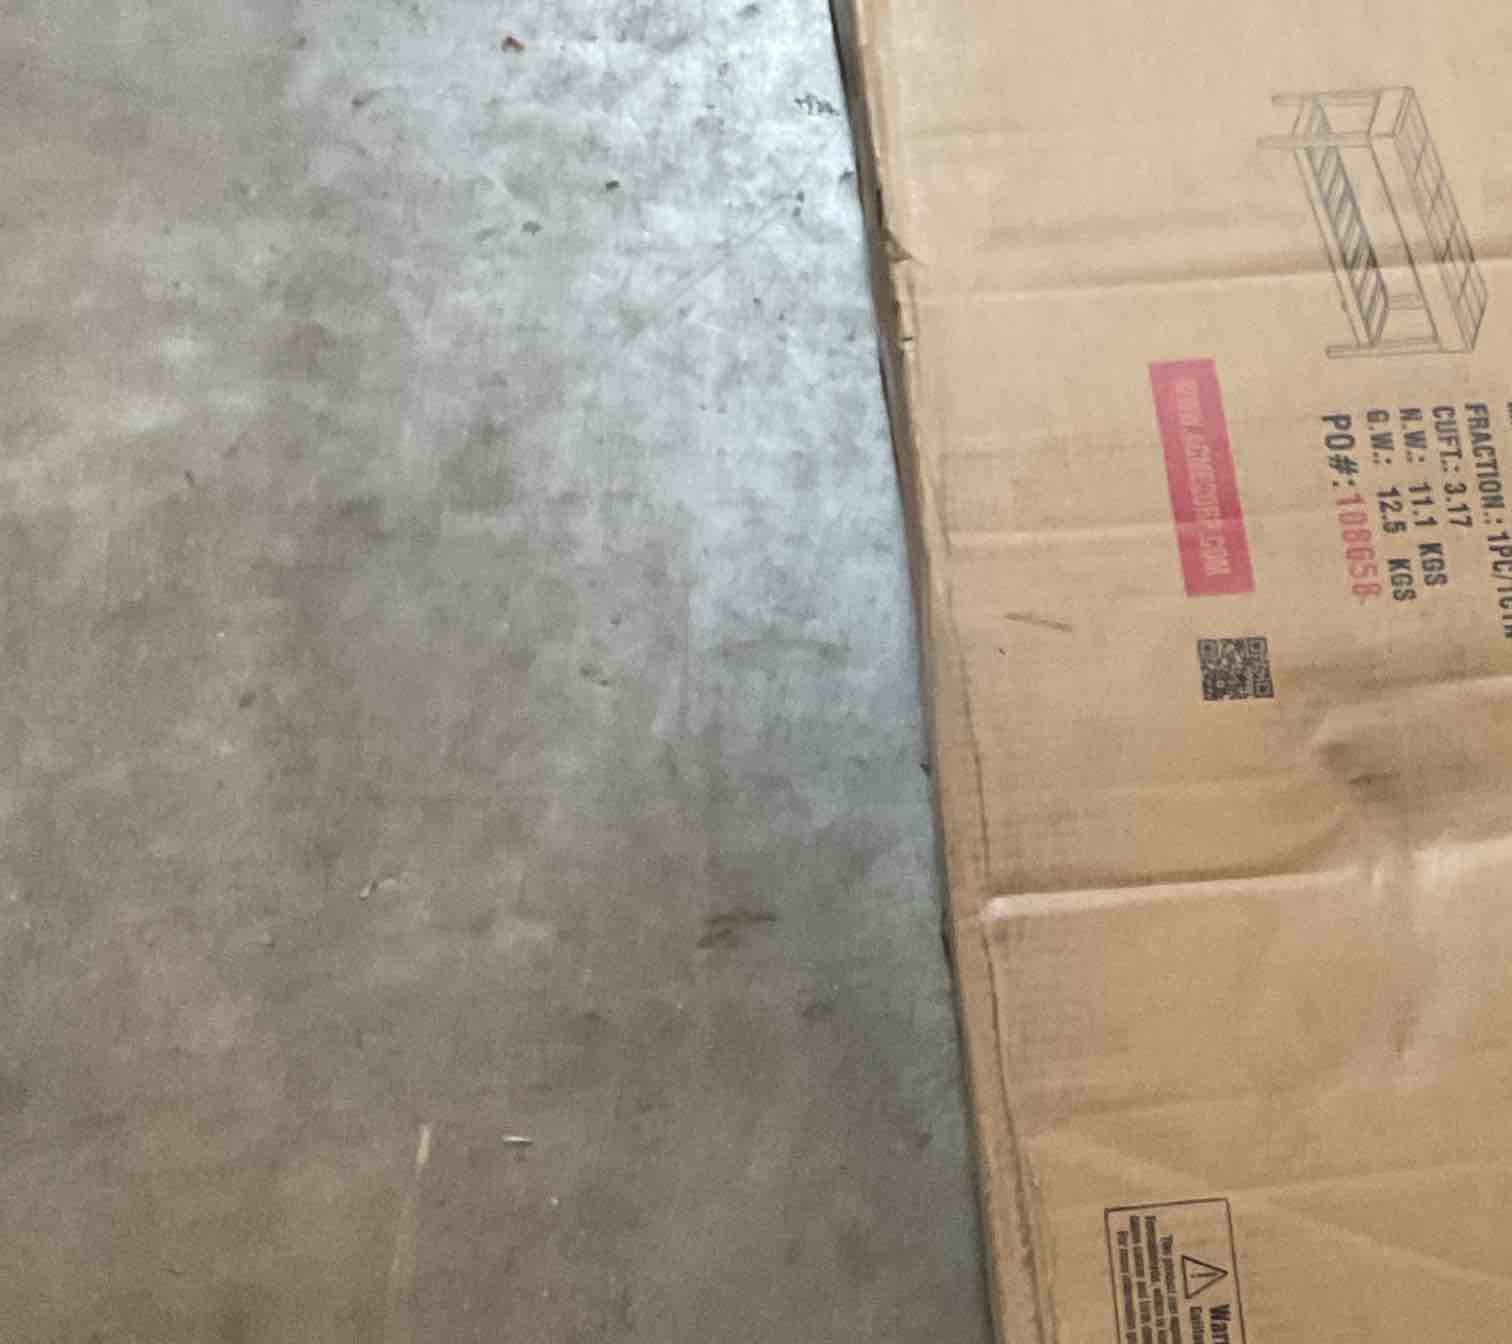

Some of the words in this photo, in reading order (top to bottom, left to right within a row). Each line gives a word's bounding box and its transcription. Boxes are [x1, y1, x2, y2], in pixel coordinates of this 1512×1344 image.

[1377, 487, 1407, 534] 12.5
[1408, 481, 1438, 527] 11.1
[1444, 482, 1473, 528] 3.17
[1388, 558, 1417, 601] KGS
[1418, 542, 1448, 587] KGS
